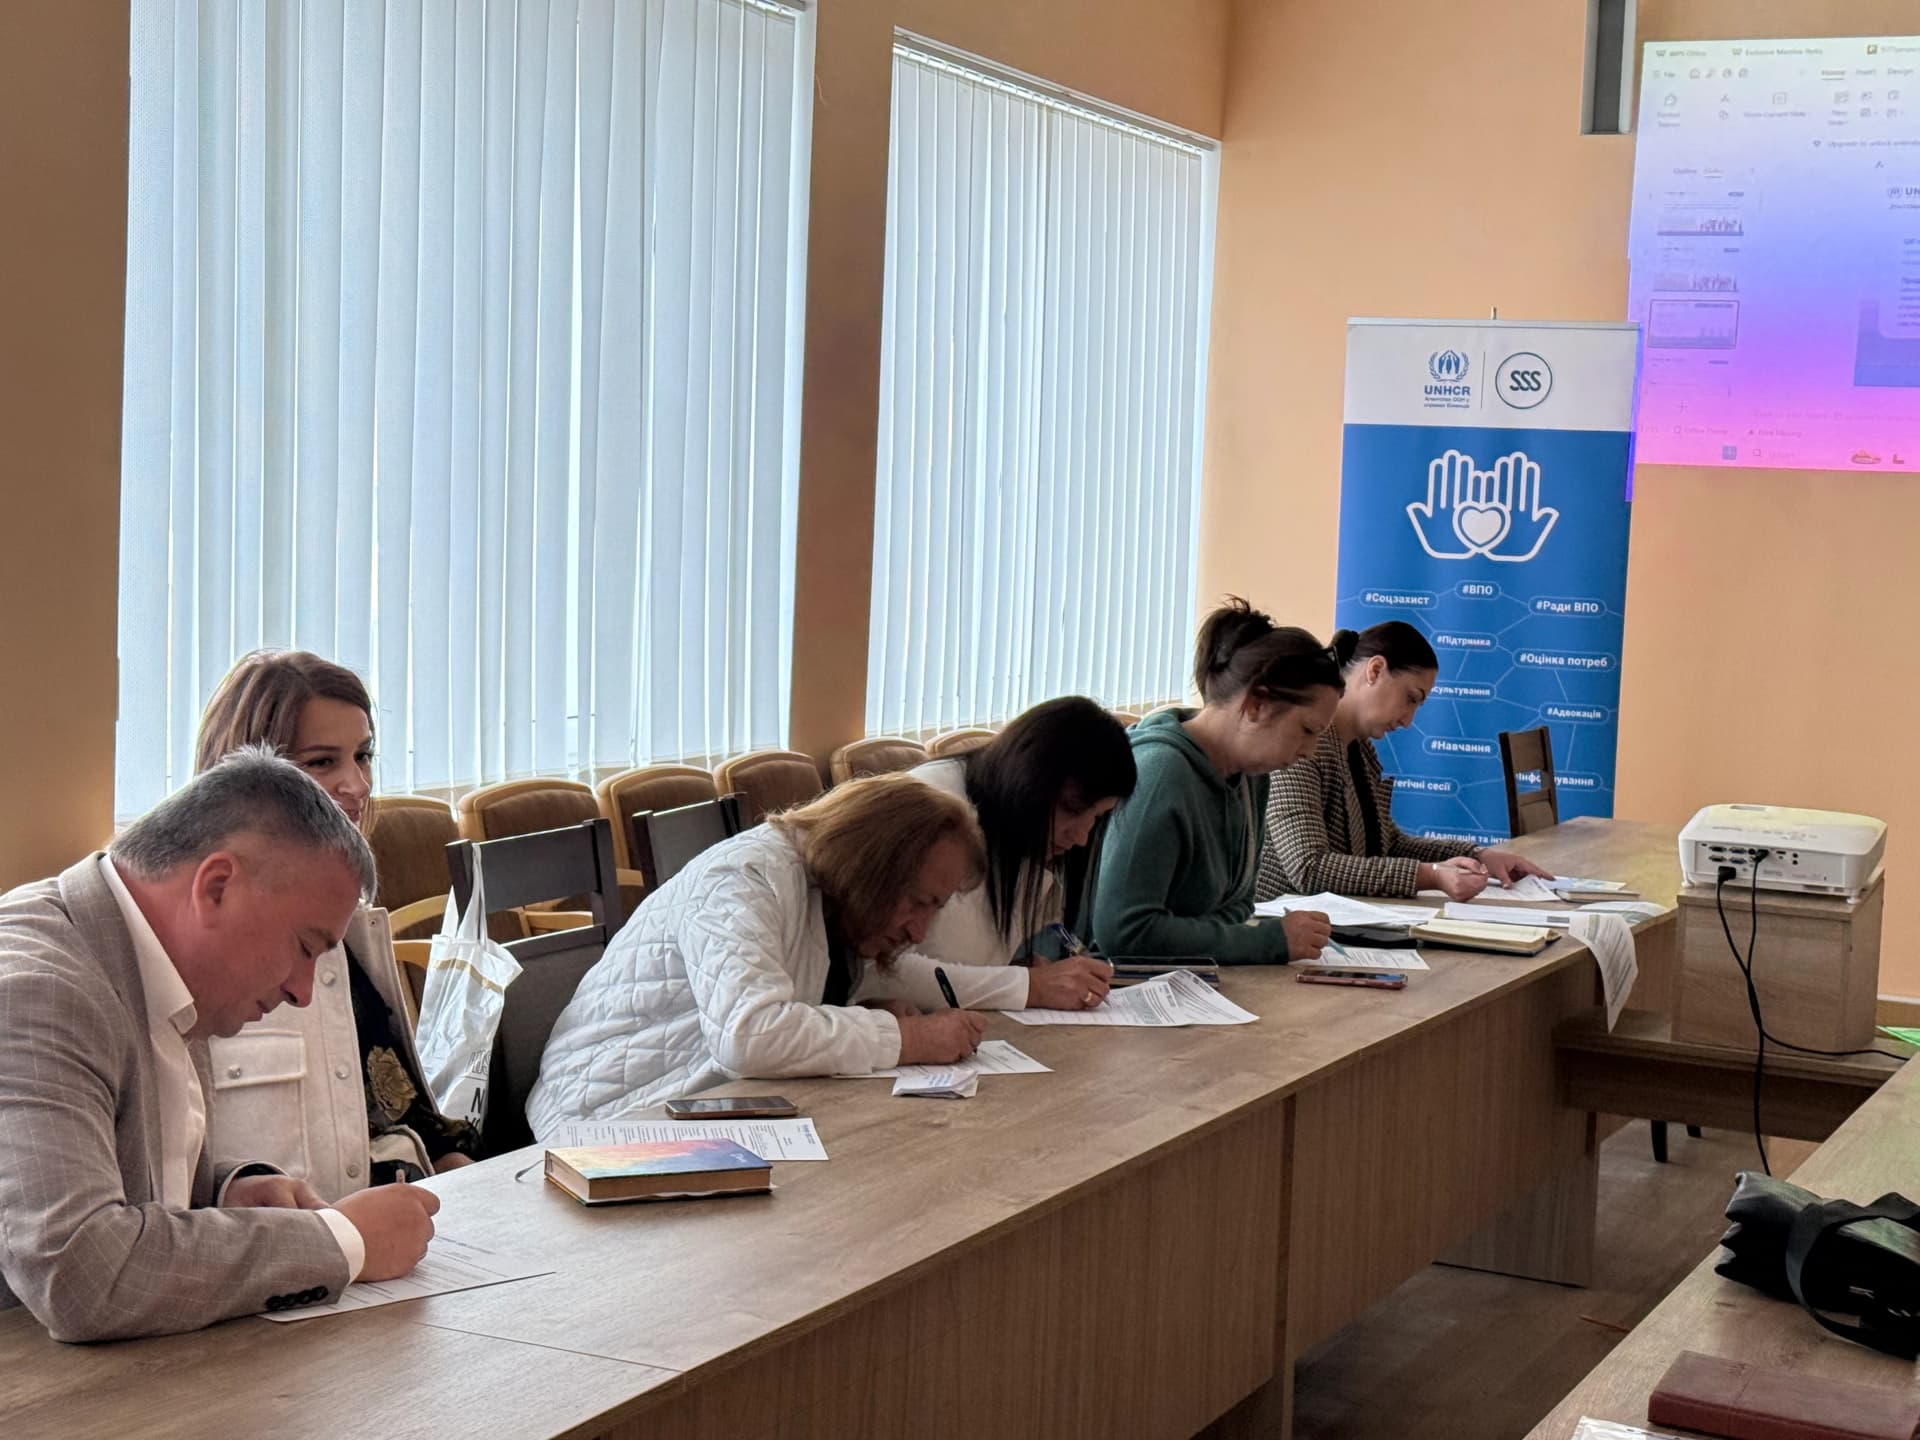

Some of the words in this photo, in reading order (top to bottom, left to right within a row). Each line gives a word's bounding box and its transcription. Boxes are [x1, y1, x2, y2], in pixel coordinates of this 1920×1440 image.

[1509, 369, 1542, 392] SSS
[1424, 385, 1471, 396] UNHCR
[1462, 584, 1493, 596] #ВПО
[1365, 592, 1430, 605] #Соцзахист
[1536, 600, 1571, 613] #Ради
[1574, 602, 1599, 613] ВПО
[1437, 635, 1491, 647] #Підтримка
[1520, 653, 1565, 667] #Оцінка
[1567, 656, 1608, 668] потреб
[1431, 686, 1490, 697] сультування
[1547, 706, 1602, 719] #Адвокація
[1431, 740, 1491, 753] #Навчання
